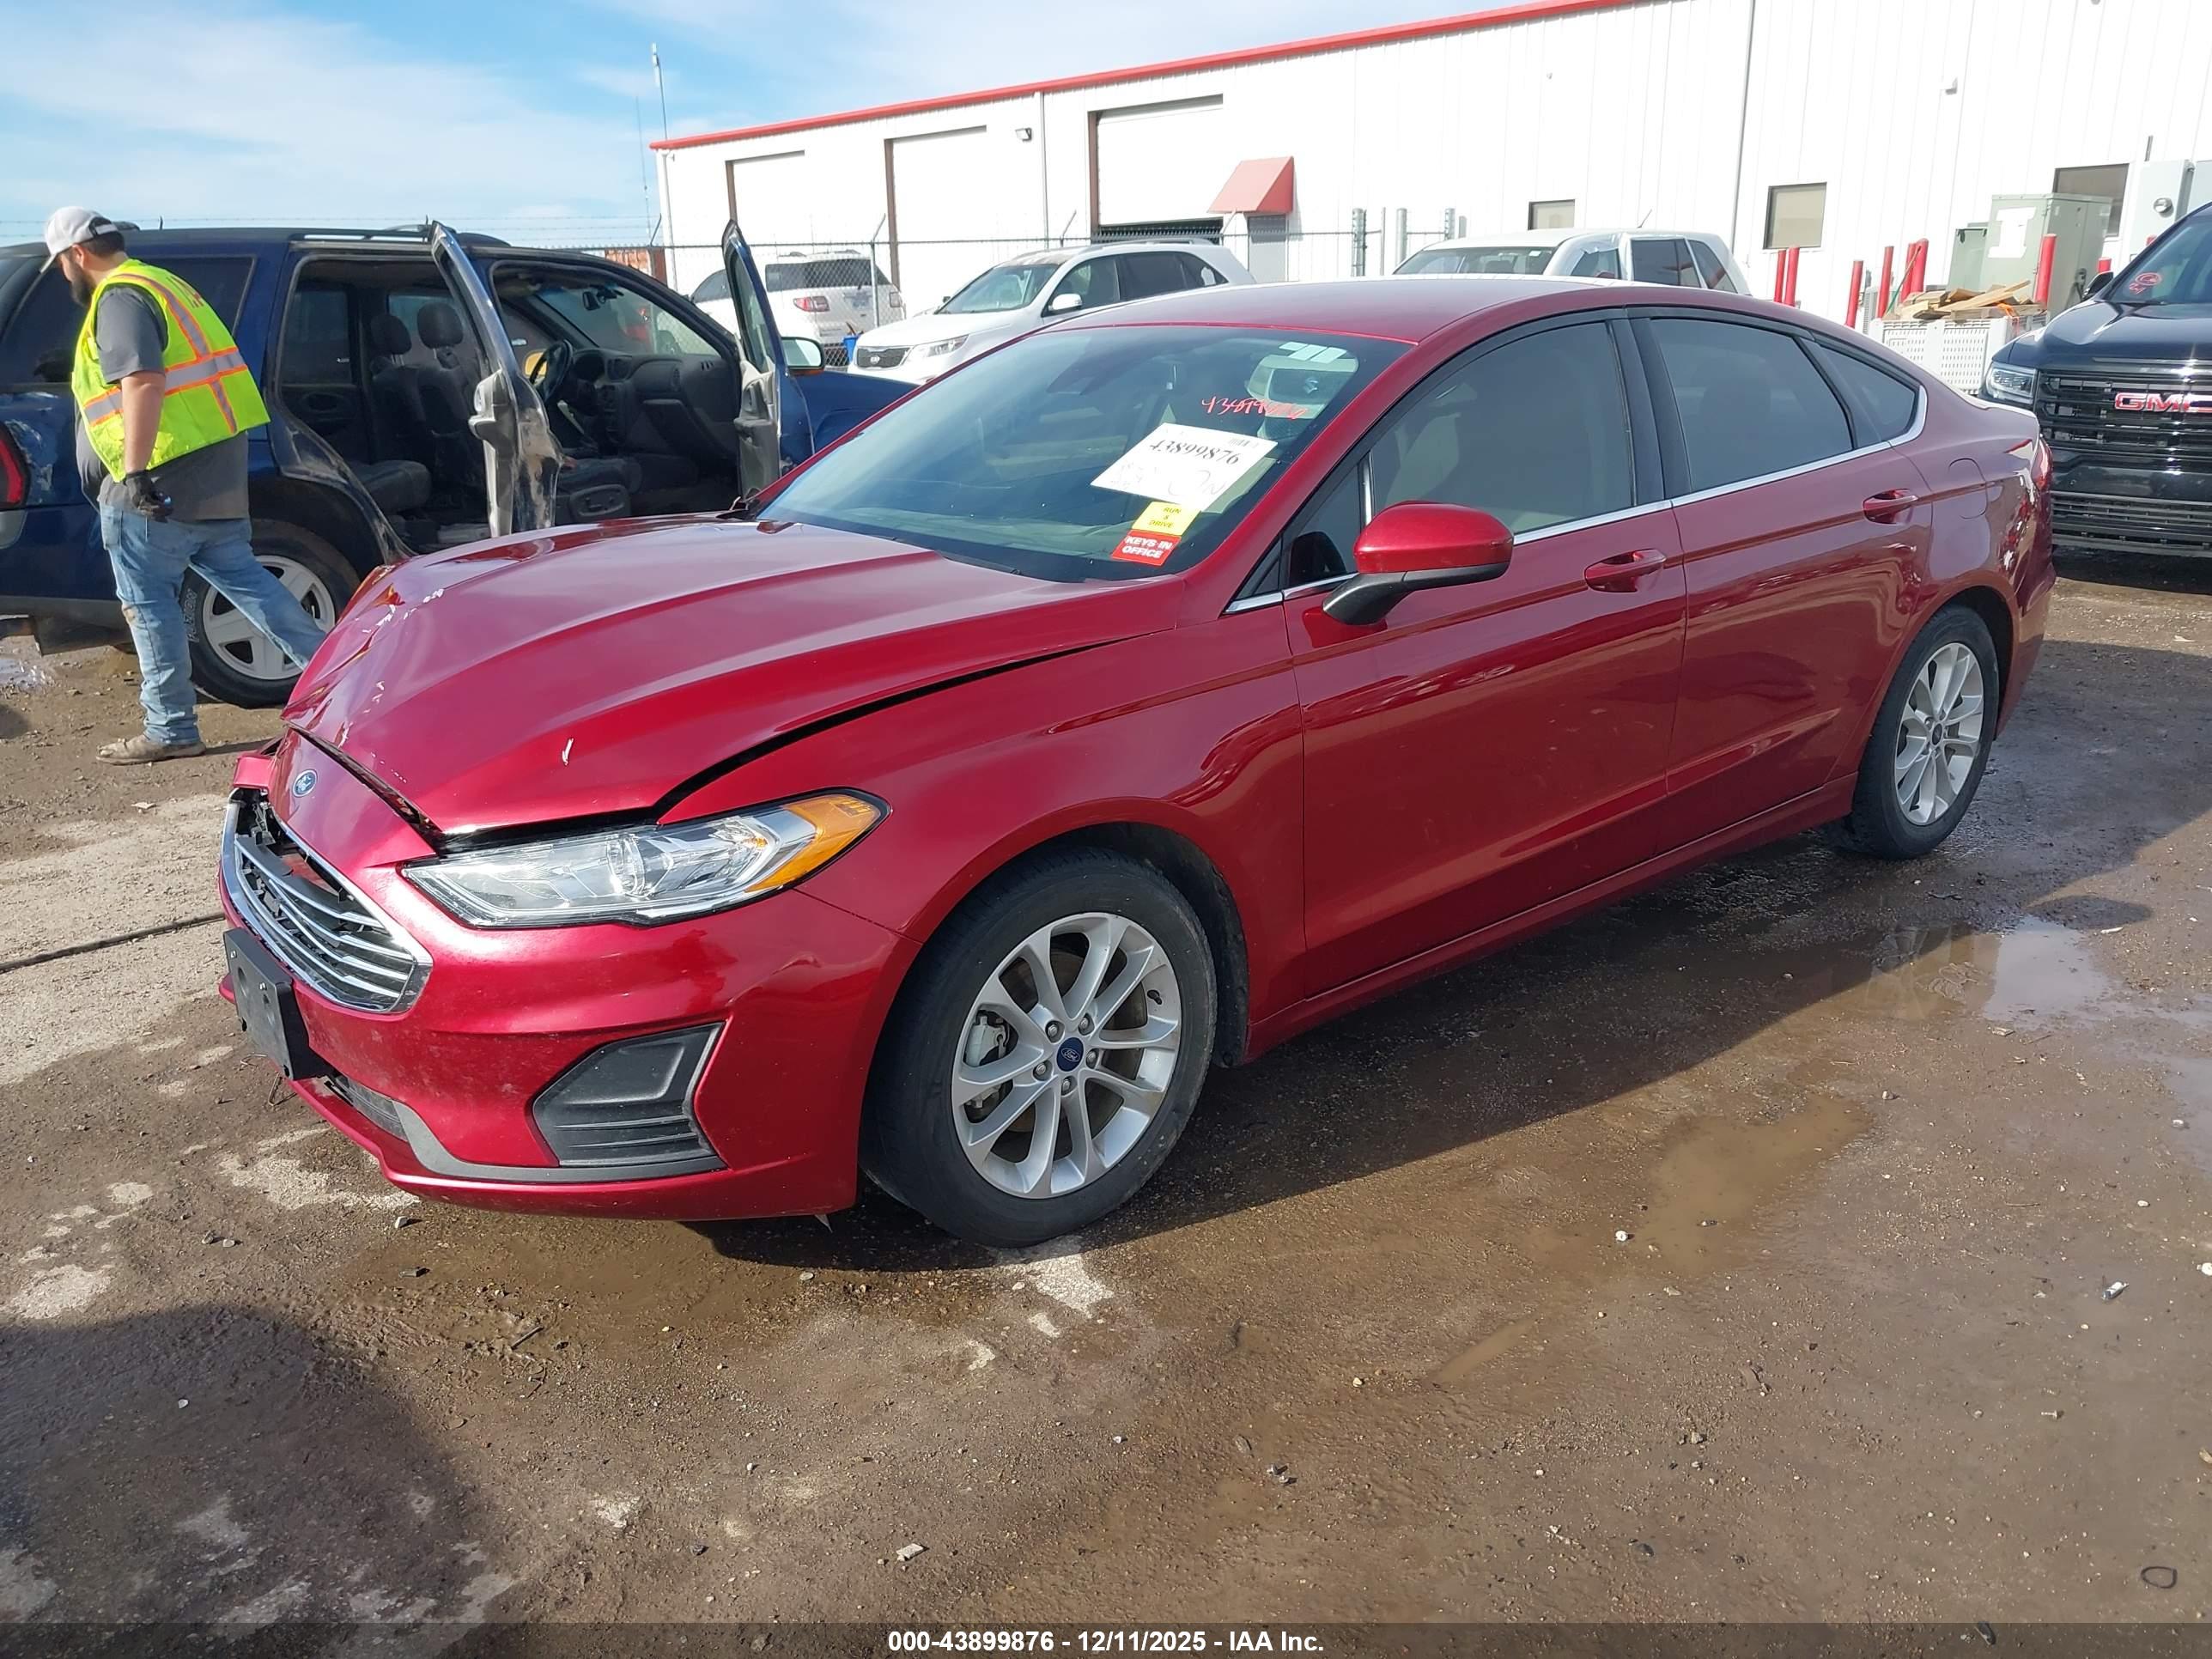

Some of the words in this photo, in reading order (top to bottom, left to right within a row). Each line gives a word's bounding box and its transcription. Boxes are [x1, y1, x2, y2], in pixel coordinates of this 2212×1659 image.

[2114, 392, 2212, 412] GMC
[1149, 439, 1240, 465] 43899876
[1125, 536, 1158, 548] KEYS
[1158, 540, 1173, 550] IN
[1121, 545, 1164, 559] OFFICE
